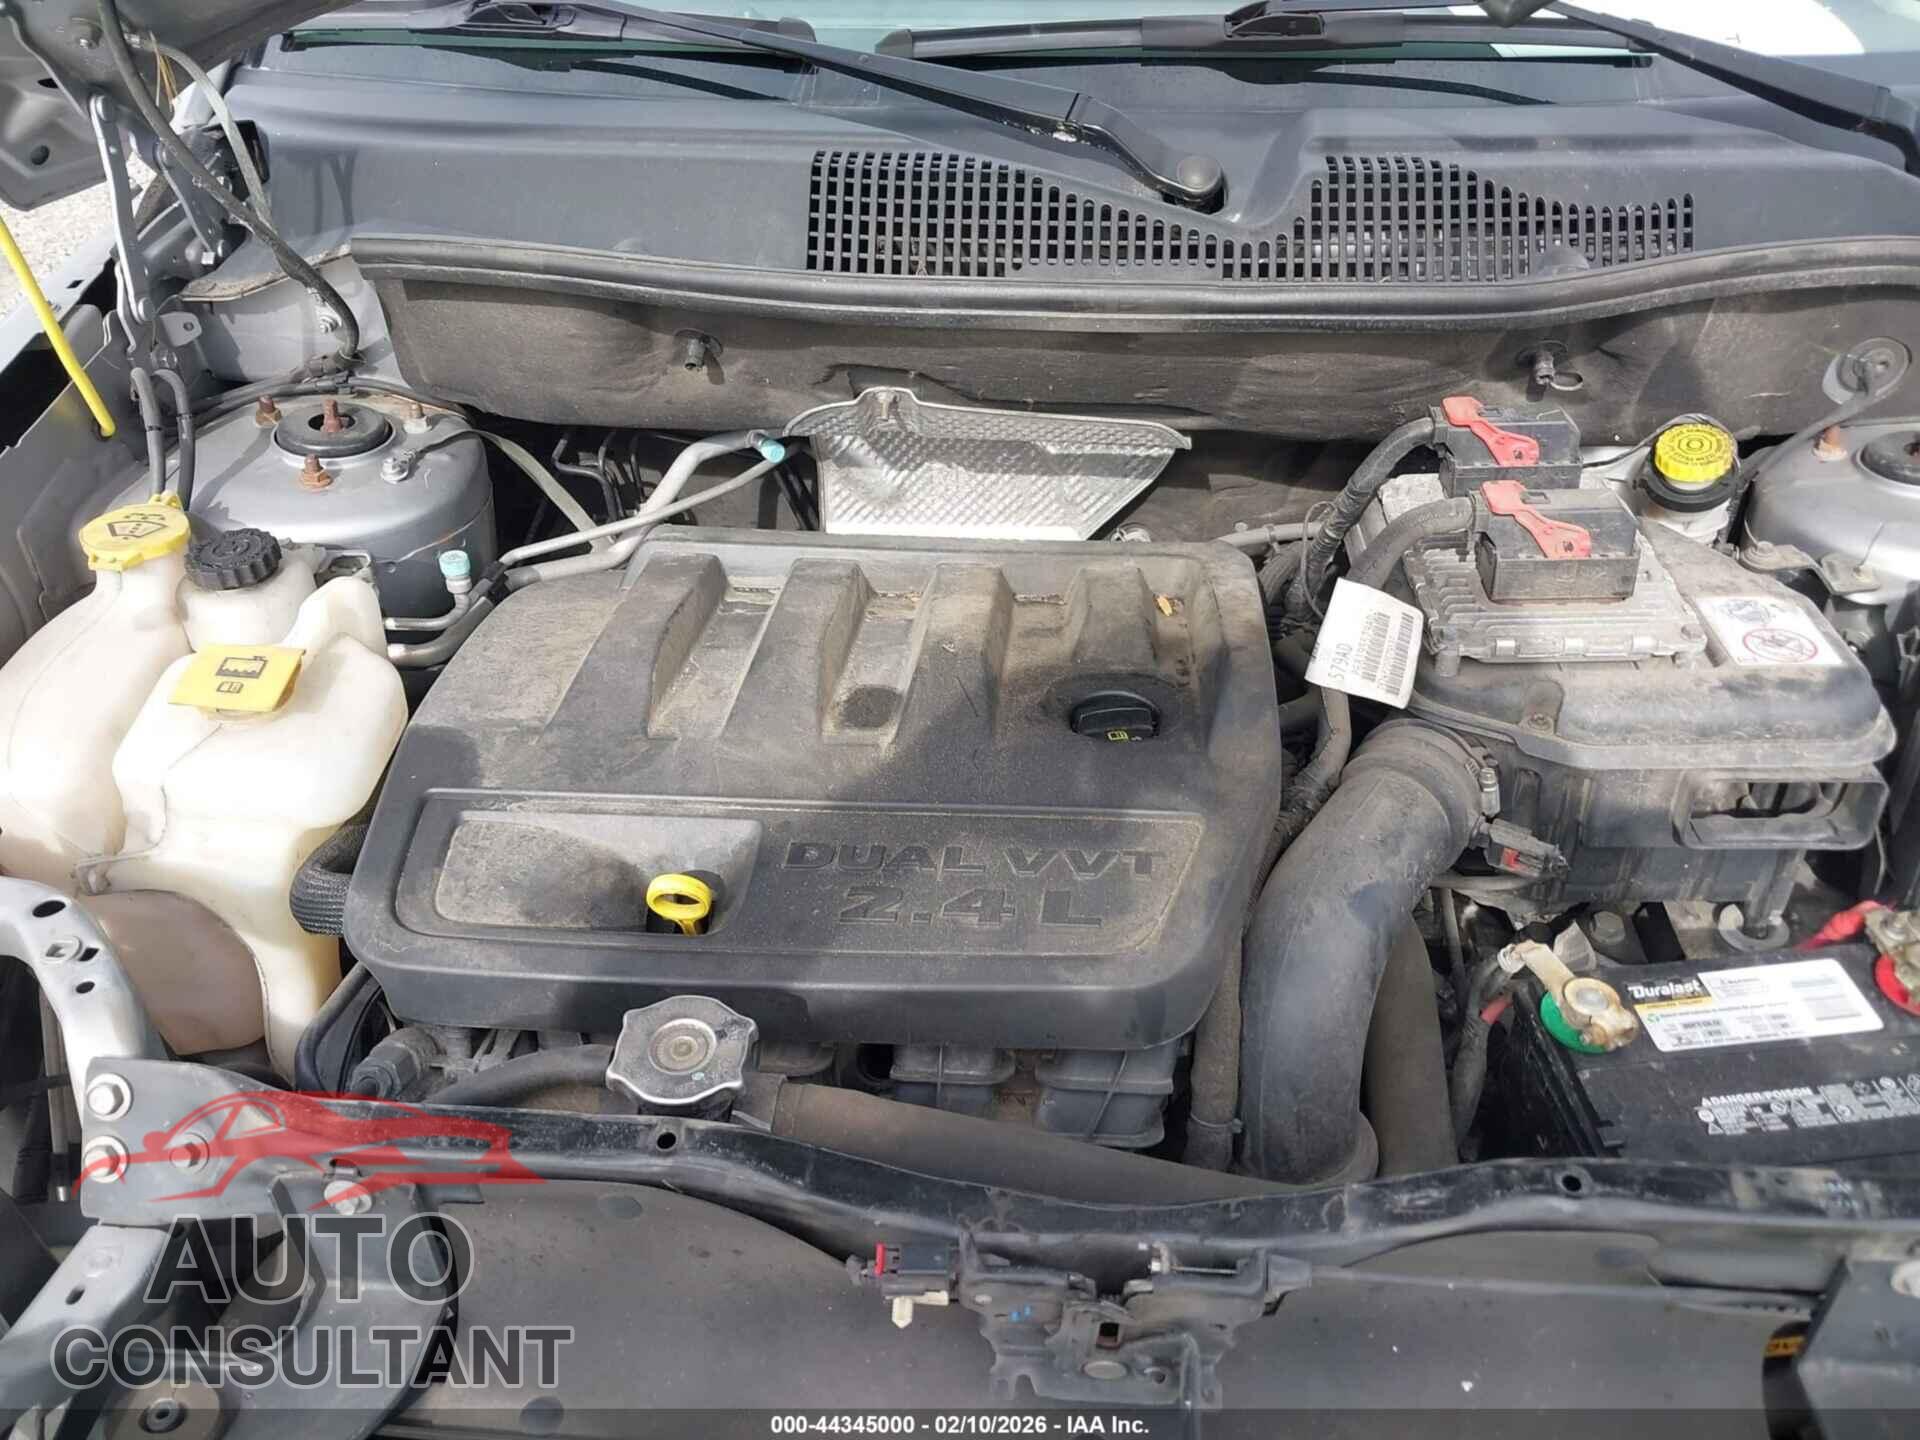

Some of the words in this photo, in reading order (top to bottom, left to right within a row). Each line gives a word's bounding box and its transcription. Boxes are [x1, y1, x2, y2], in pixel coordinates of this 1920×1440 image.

[782, 842, 986, 873] DUAL
[1002, 848, 1160, 880] VVT
[1628, 980, 1701, 999] Duralast
